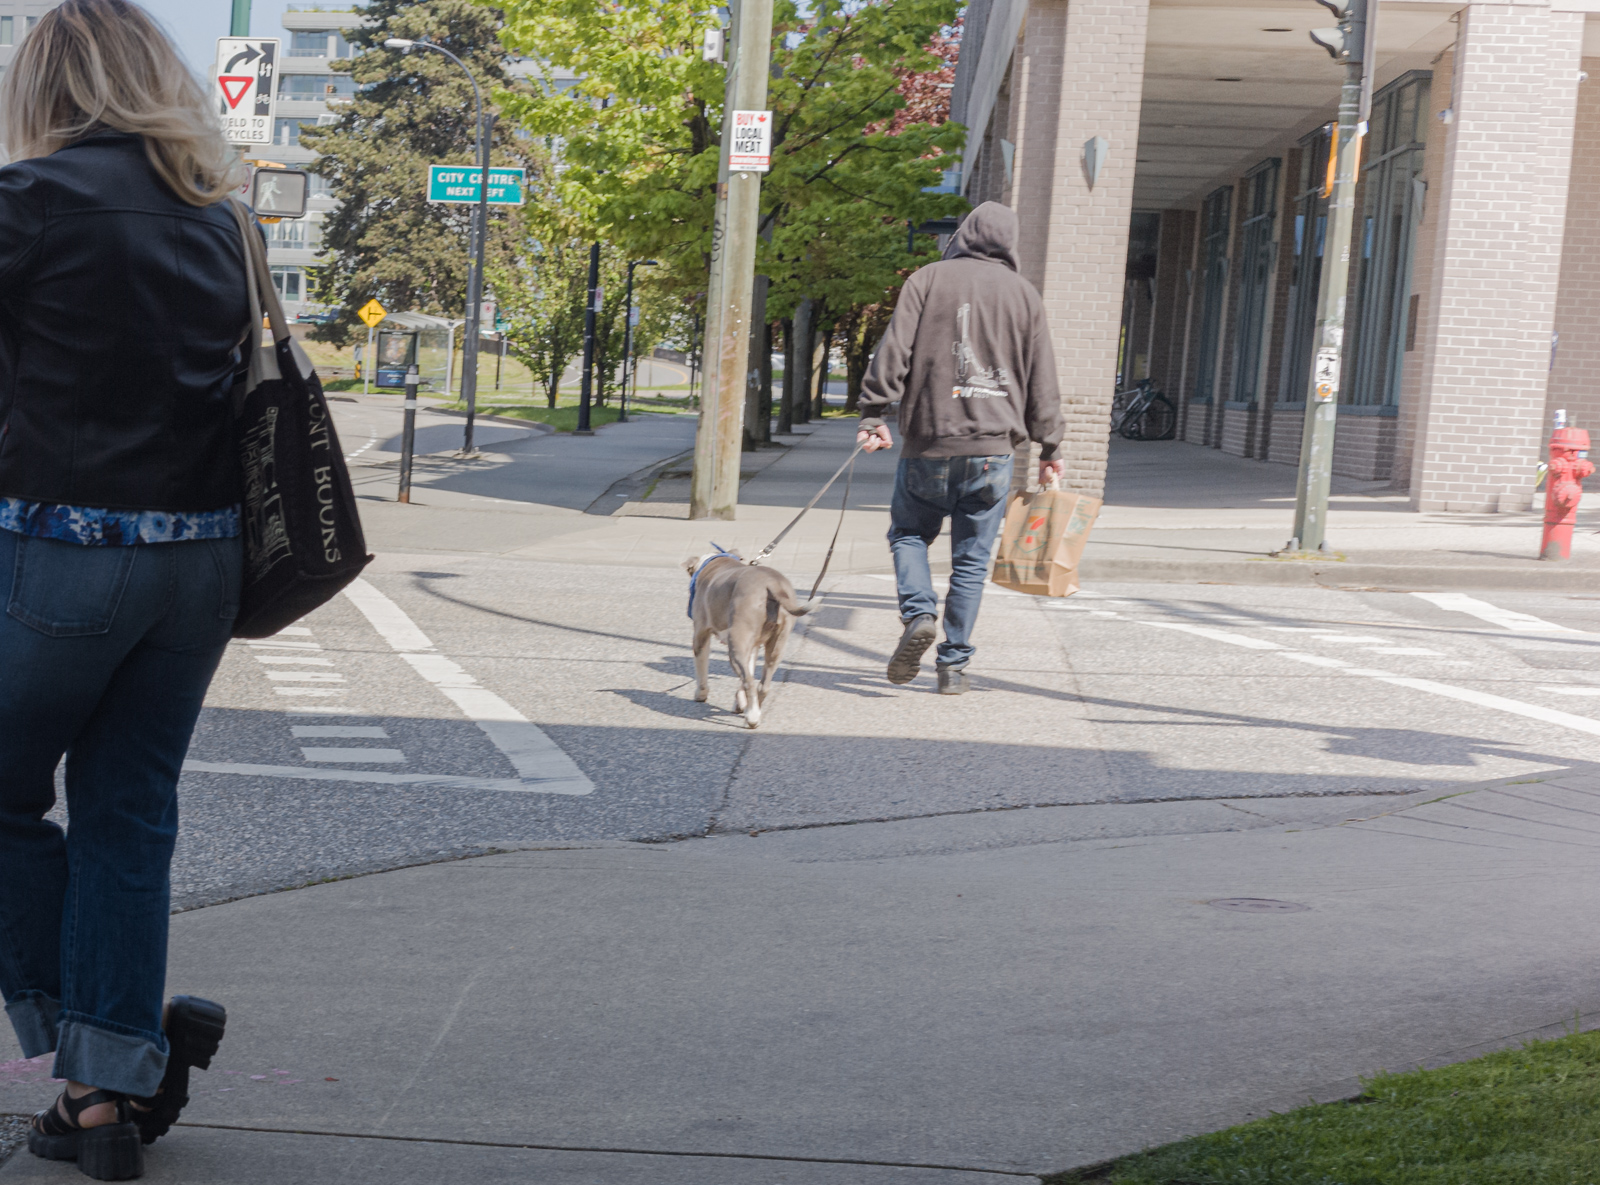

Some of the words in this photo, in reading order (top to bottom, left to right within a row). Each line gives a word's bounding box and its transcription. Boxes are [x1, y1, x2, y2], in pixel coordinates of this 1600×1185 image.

[251, 118, 265, 128] TO
[737, 113, 754, 125] BUY
[227, 130, 264, 139] CYCLES
[735, 127, 763, 139] LOCAL
[734, 141, 761, 153] MEAT
[437, 172, 465, 183] CITY
[446, 187, 475, 196] NEXT
[486, 188, 505, 197] EFT
[309, 393, 331, 450] UNT
